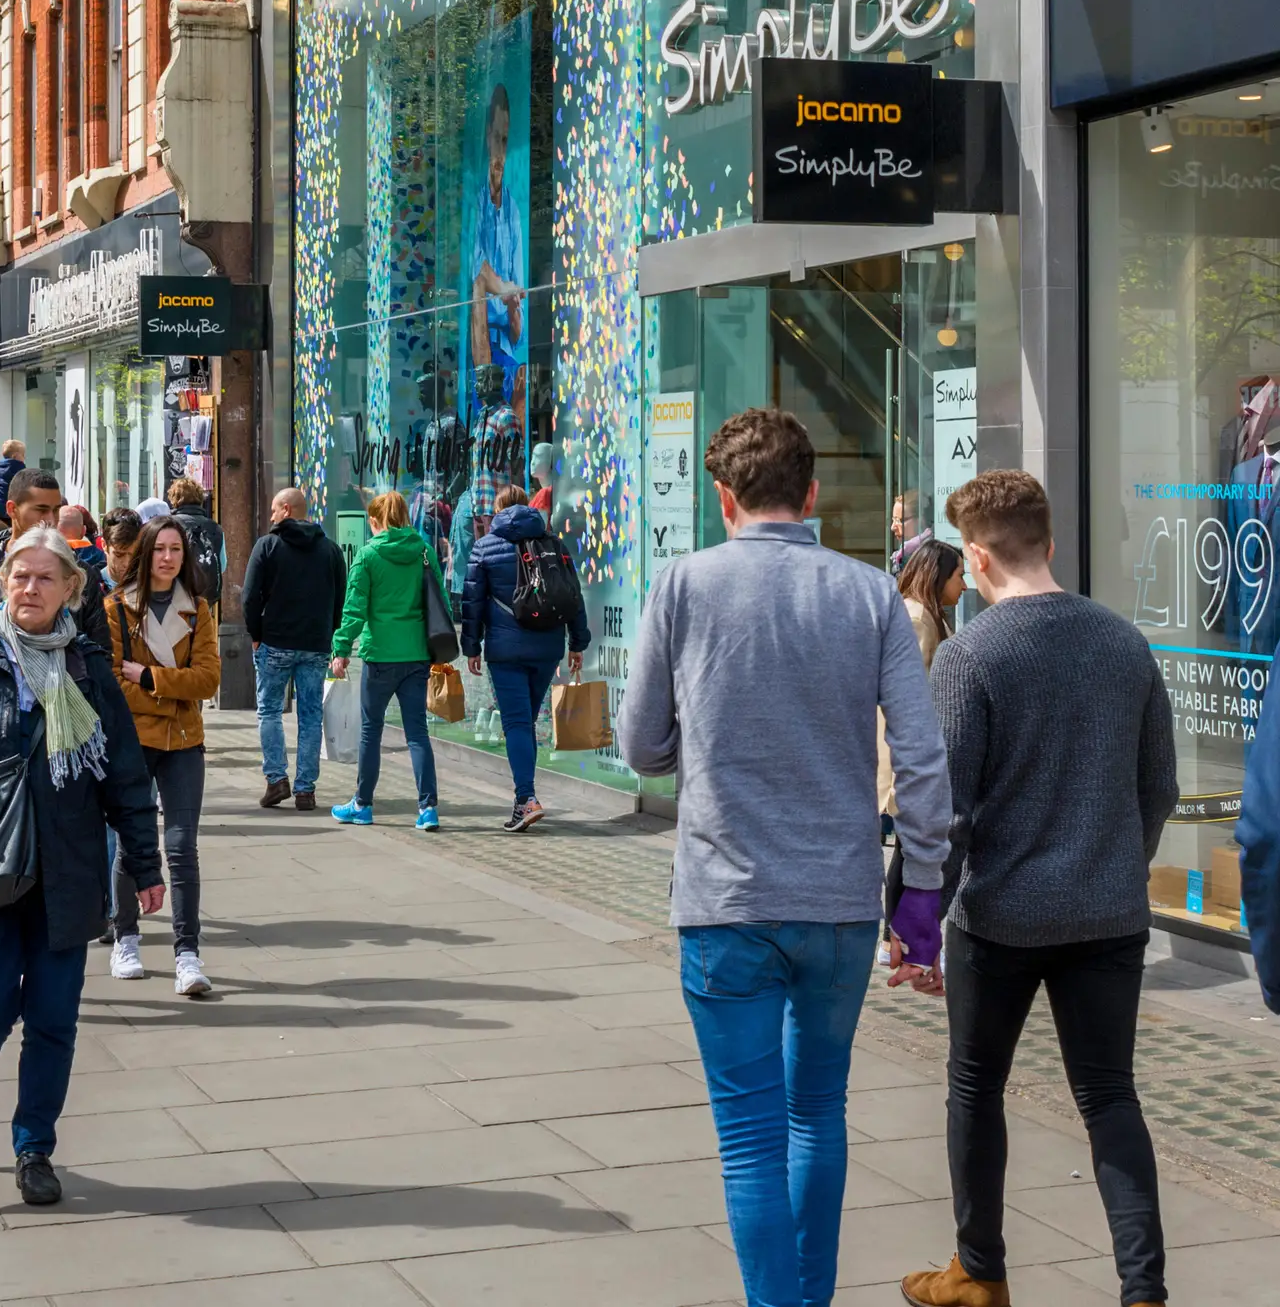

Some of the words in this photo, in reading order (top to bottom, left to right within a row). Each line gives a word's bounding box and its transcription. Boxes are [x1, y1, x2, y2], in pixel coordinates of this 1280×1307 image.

[796, 95, 902, 126] jacamo
[775, 145, 922, 187] SimplyBe
[158, 293, 214, 309] jacamo
[147, 318, 225, 338] SimplyBe
[935, 379, 977, 410] Simply
[652, 398, 693, 427] jacamo
[352, 412, 401, 491] Spring
[1133, 484, 1153, 498] THE
[1156, 484, 1245, 499] CONTEMPORARY
[1248, 484, 1273, 500] SUIT
[1134, 517, 1274, 635] £199
[604, 606, 623, 638] FREE
[598, 645, 621, 680] CLICK
[1176, 660, 1214, 685] NEW
[1185, 716, 1237, 739] QUALITY
[1175, 805, 1195, 815] TAILOR
[1196, 804, 1205, 814] ME
